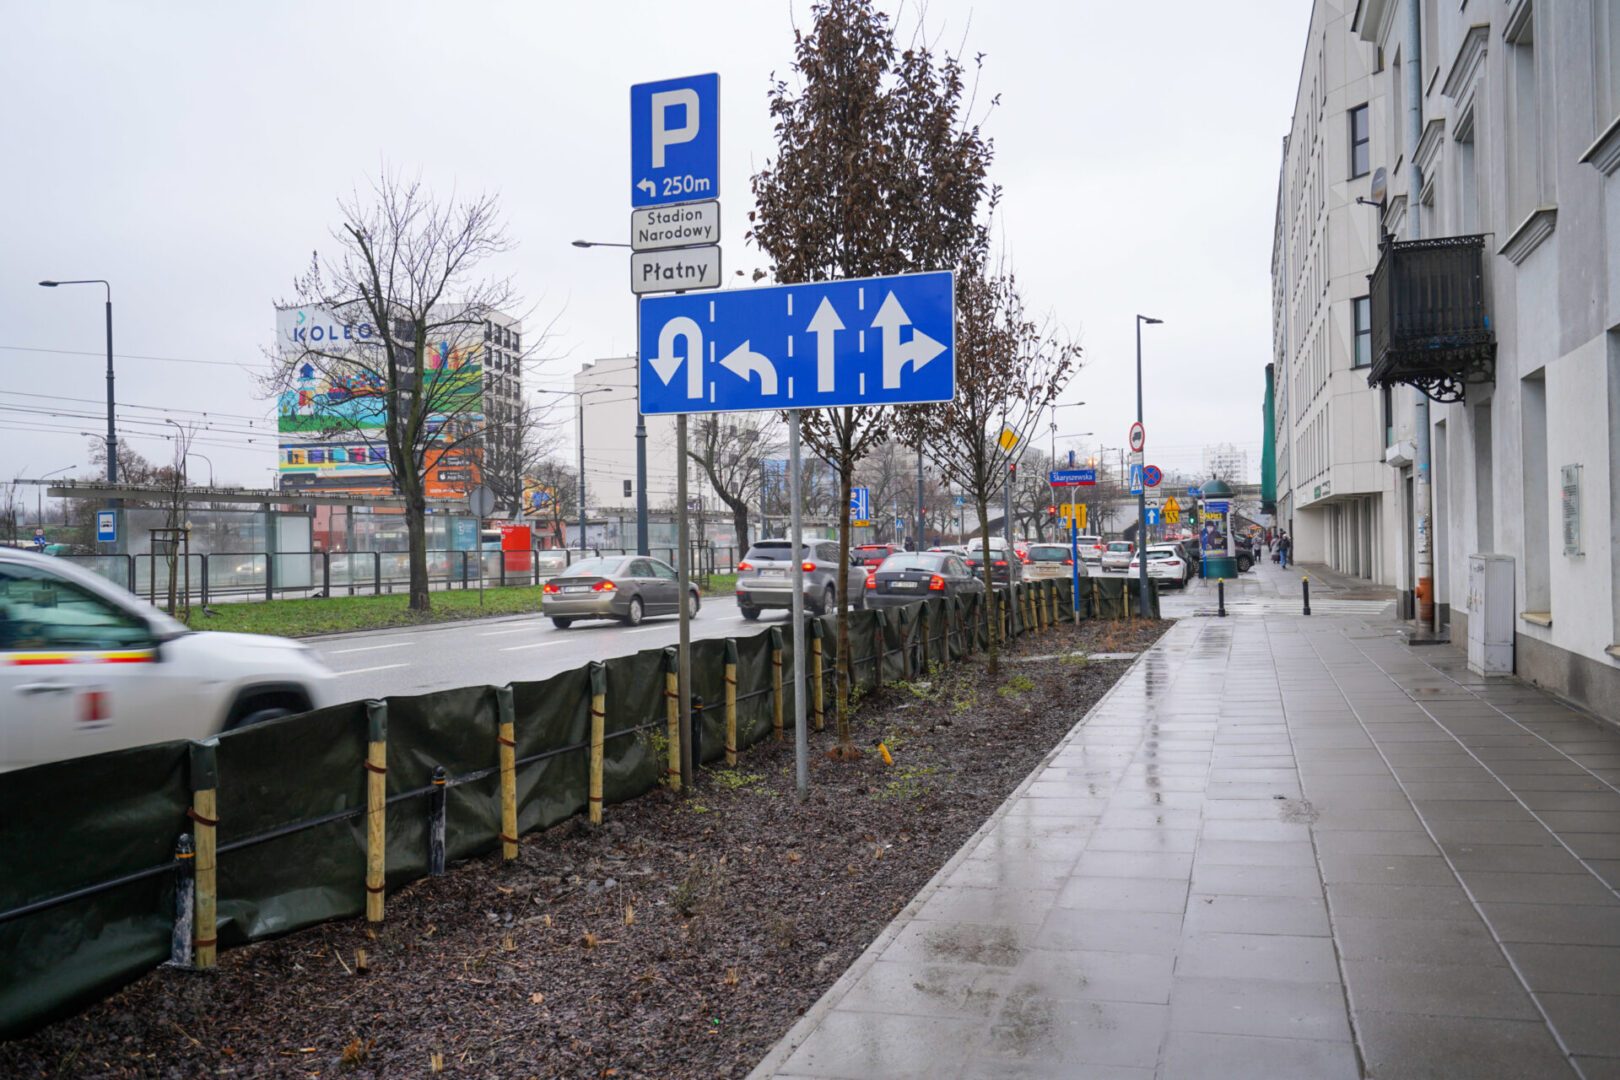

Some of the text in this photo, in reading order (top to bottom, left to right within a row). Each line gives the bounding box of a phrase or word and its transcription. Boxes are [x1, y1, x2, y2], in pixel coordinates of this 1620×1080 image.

[652, 88, 700, 169] P
[663, 174, 710, 196] 250m
[648, 209, 703, 226] Stadion
[639, 225, 712, 243] Narodowy
[643, 261, 708, 283] Płatny
[293, 323, 372, 342] KOLEO
